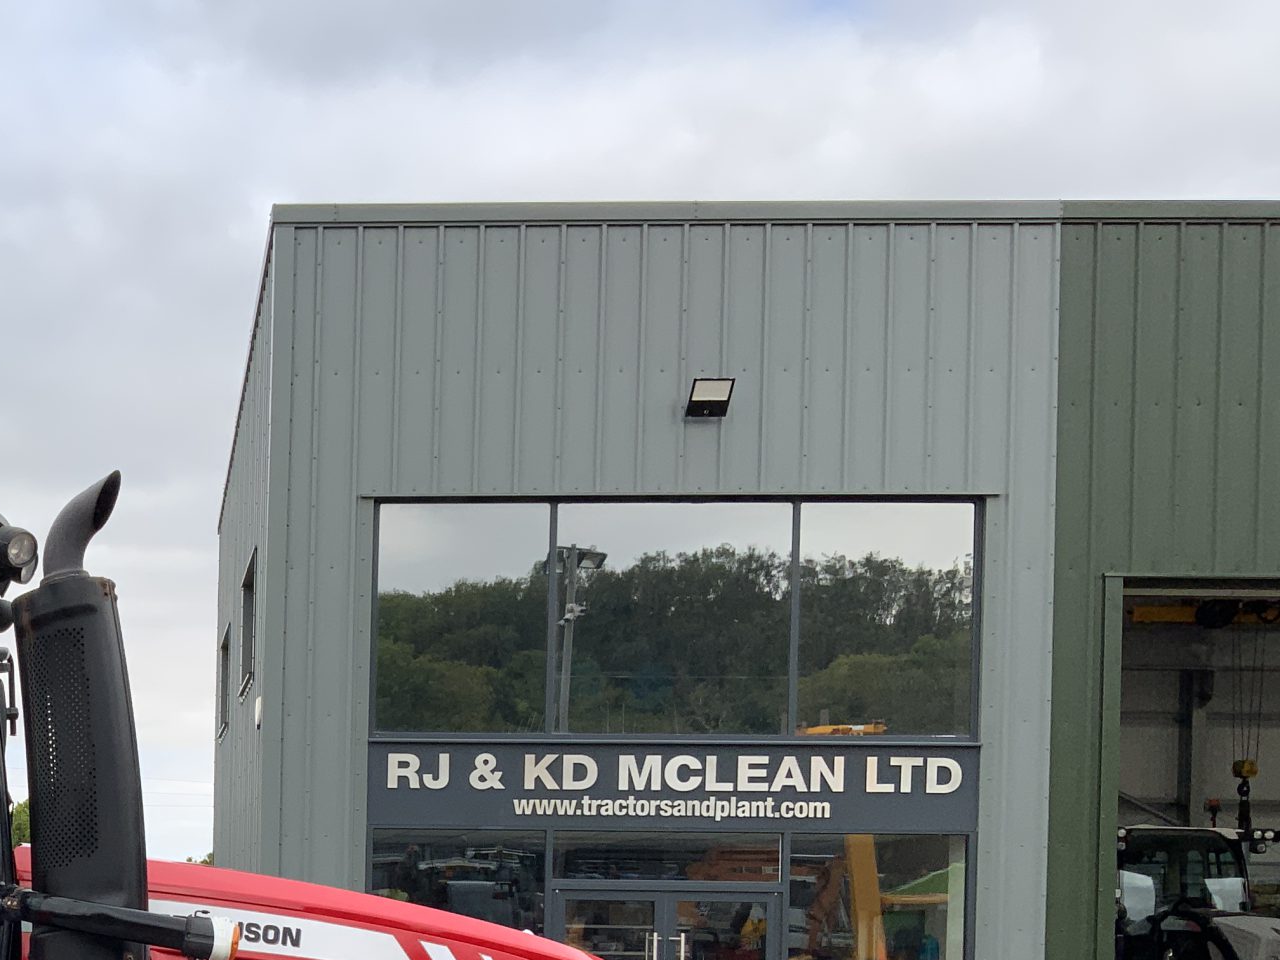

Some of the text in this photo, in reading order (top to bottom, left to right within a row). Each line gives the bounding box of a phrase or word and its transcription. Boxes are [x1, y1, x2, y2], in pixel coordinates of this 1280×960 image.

[386, 751, 964, 795] RJ & KD MCLEAN LTD
[512, 795, 832, 822] www.tractorsandplant.com
[238, 921, 302, 948] SON
